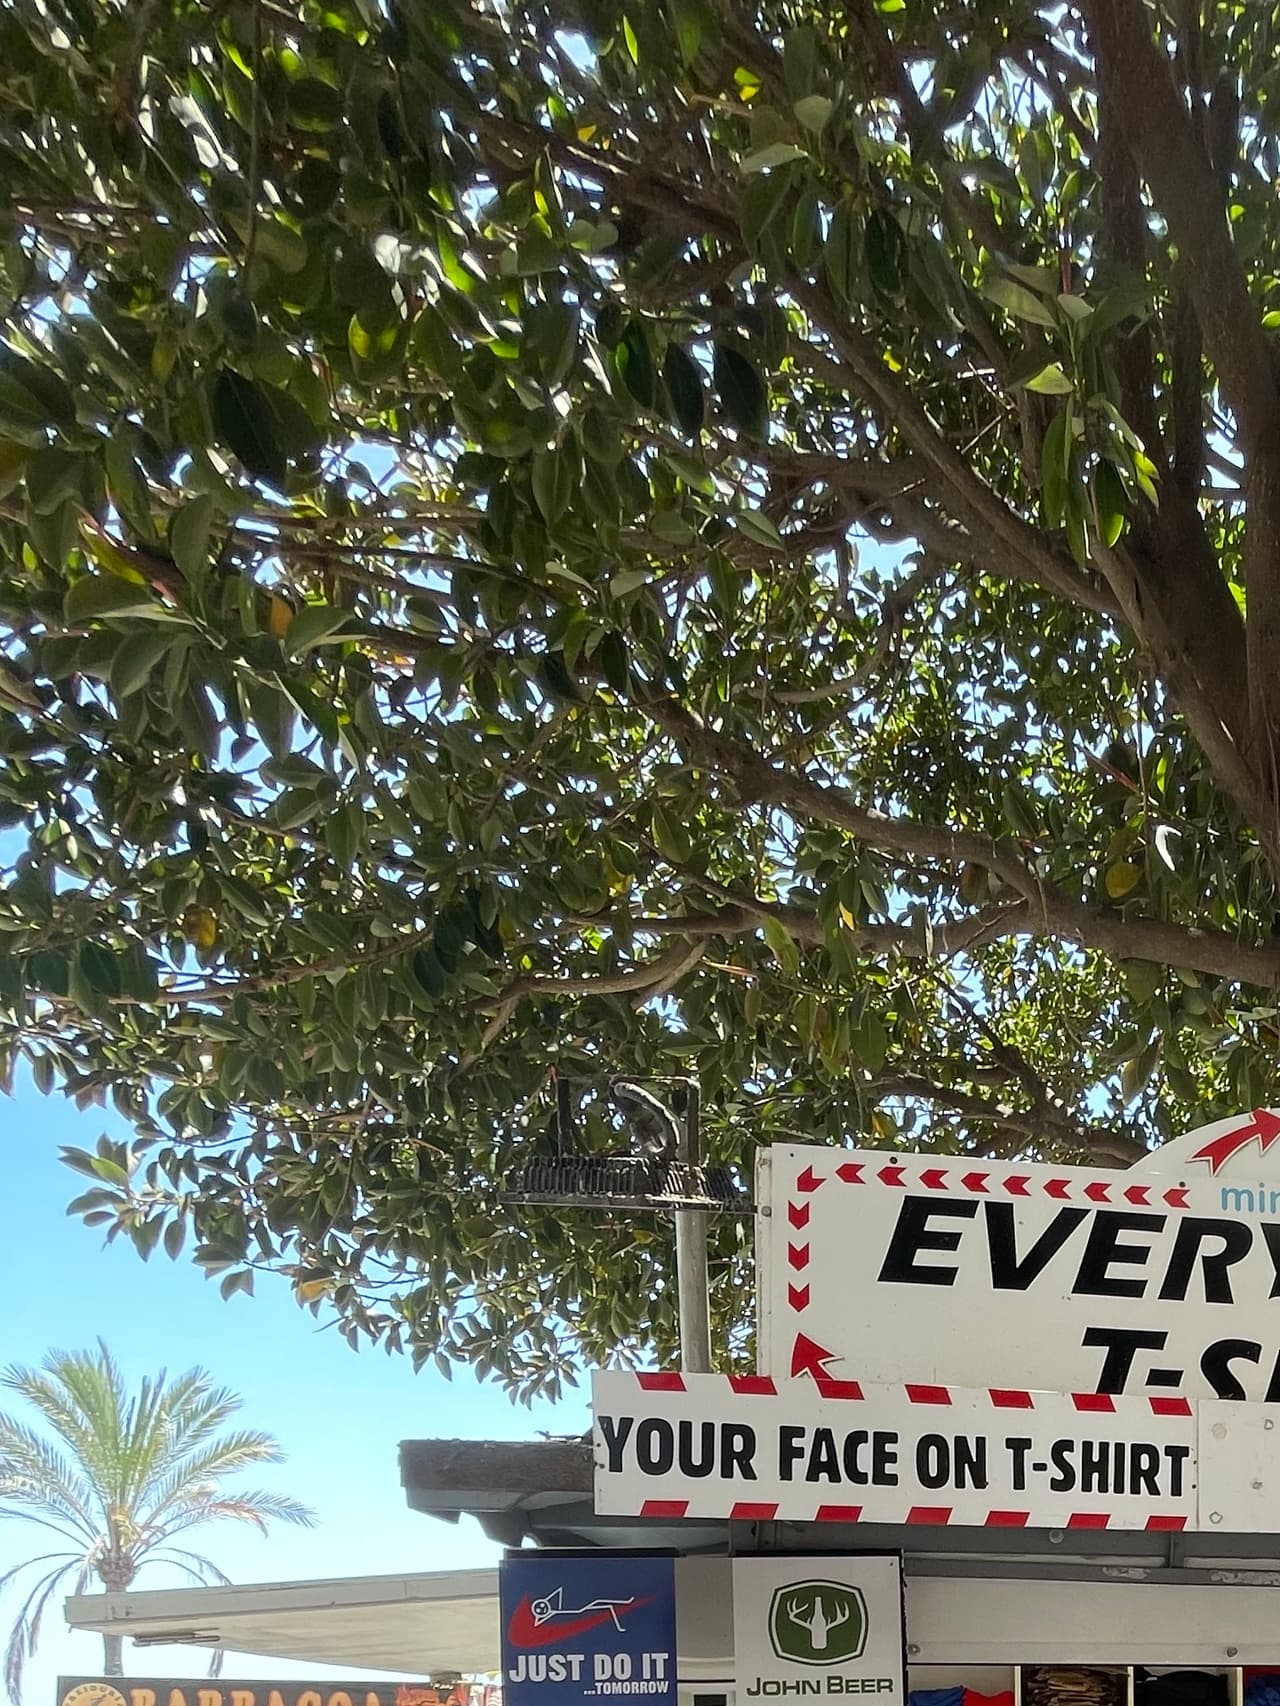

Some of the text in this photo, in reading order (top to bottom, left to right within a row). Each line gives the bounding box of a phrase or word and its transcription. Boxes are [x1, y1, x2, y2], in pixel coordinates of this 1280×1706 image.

[598, 1416, 1190, 1497] YOUR FACE ON T-SHIRT
[509, 1652, 669, 1682] JUST DO IT
[583, 1681, 669, 1696] ...TOMORROW
